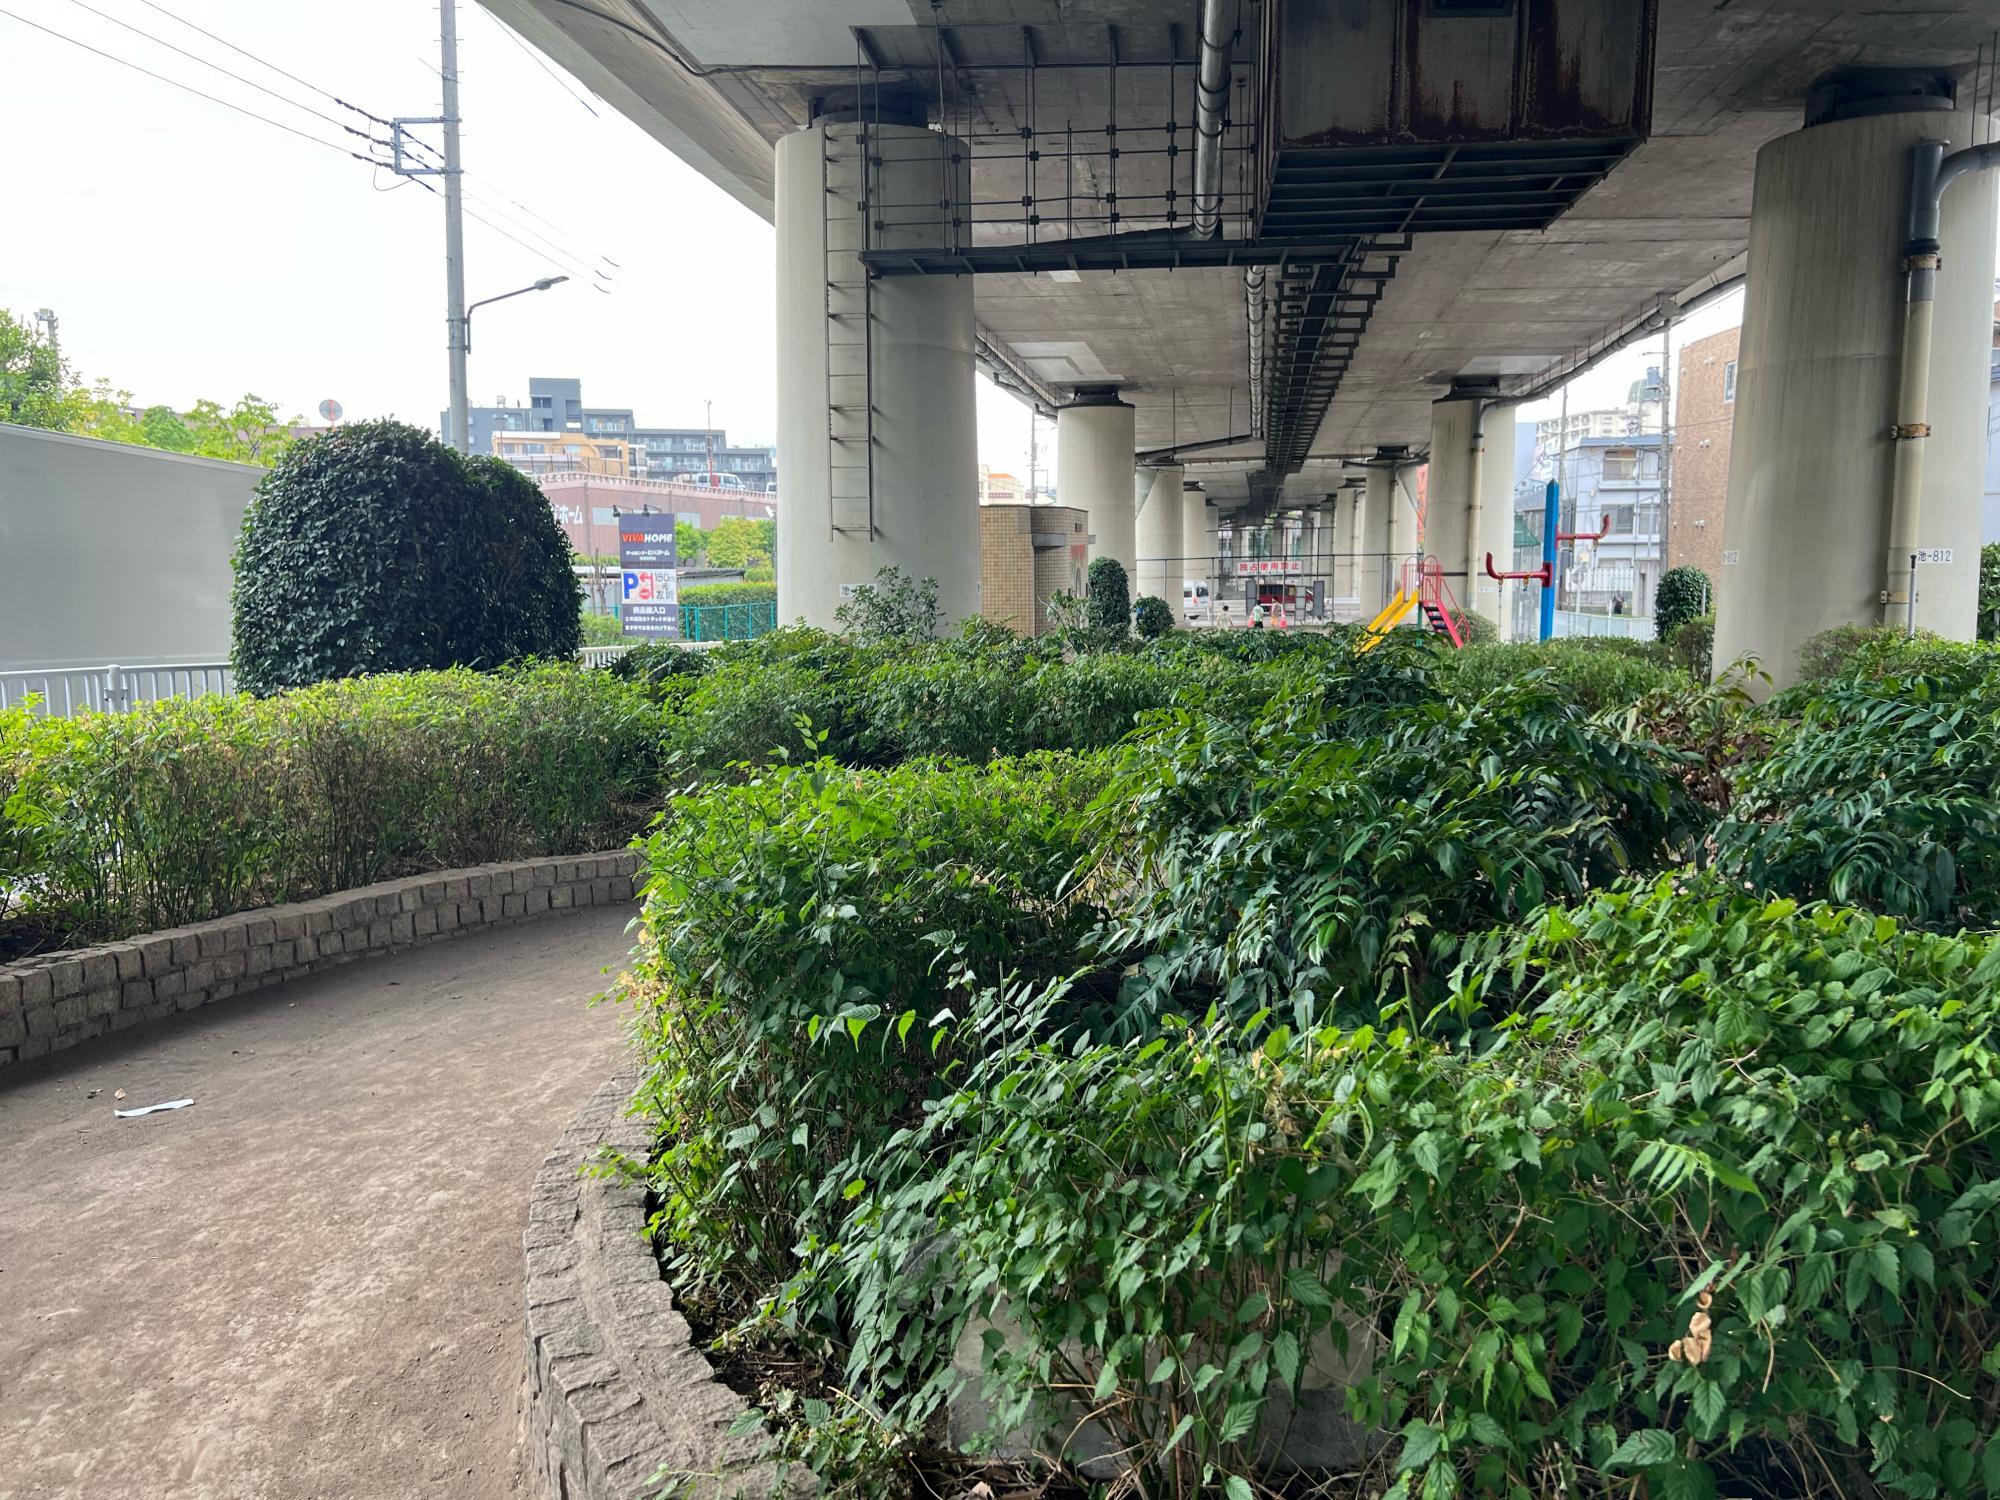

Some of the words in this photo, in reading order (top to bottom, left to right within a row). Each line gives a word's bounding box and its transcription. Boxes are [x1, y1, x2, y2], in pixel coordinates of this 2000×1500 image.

[622, 533, 673, 543] VIVAHOME
[1239, 562, 1300, 571] 独占使用禁止
[623, 573, 639, 599] P
